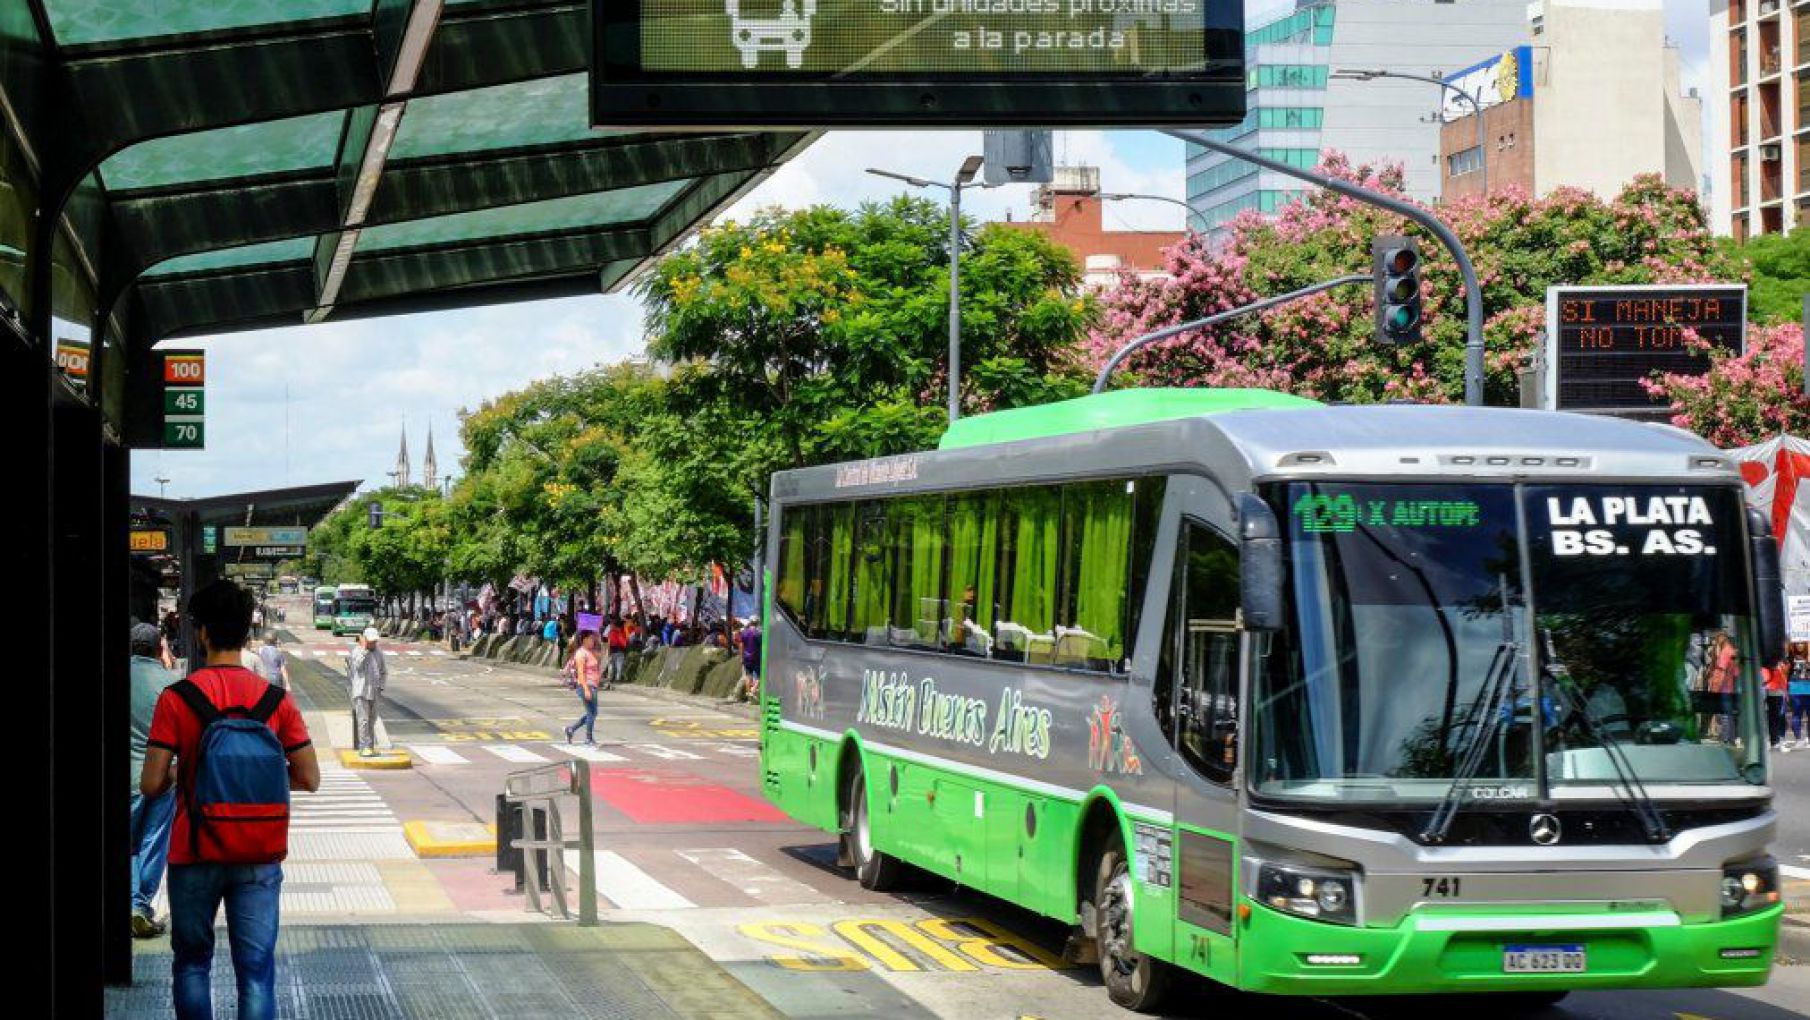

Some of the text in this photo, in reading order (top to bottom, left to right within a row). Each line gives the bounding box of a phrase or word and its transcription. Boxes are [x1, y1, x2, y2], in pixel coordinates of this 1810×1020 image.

[953, 26, 1125, 54] a la parada
[1561, 297, 1721, 322] SI MANEJA
[1580, 326, 1615, 349] NO
[170, 361, 201, 378] 100
[174, 393, 198, 409] 45
[175, 425, 198, 441] 70
[1293, 494, 1355, 533] 129
[1367, 500, 1386, 525] X
[1547, 496, 1714, 525] LA PLATA
[1551, 529, 1718, 556] BS. AS.
[917, 677, 987, 746] Buenos
[989, 686, 1052, 760] Aires
[1421, 876, 1461, 897] 741
[737, 915, 1068, 972] BUS
[1190, 933, 1213, 969] 741
[1507, 952, 1527, 970] AC
[1531, 952, 1559, 970] 623
